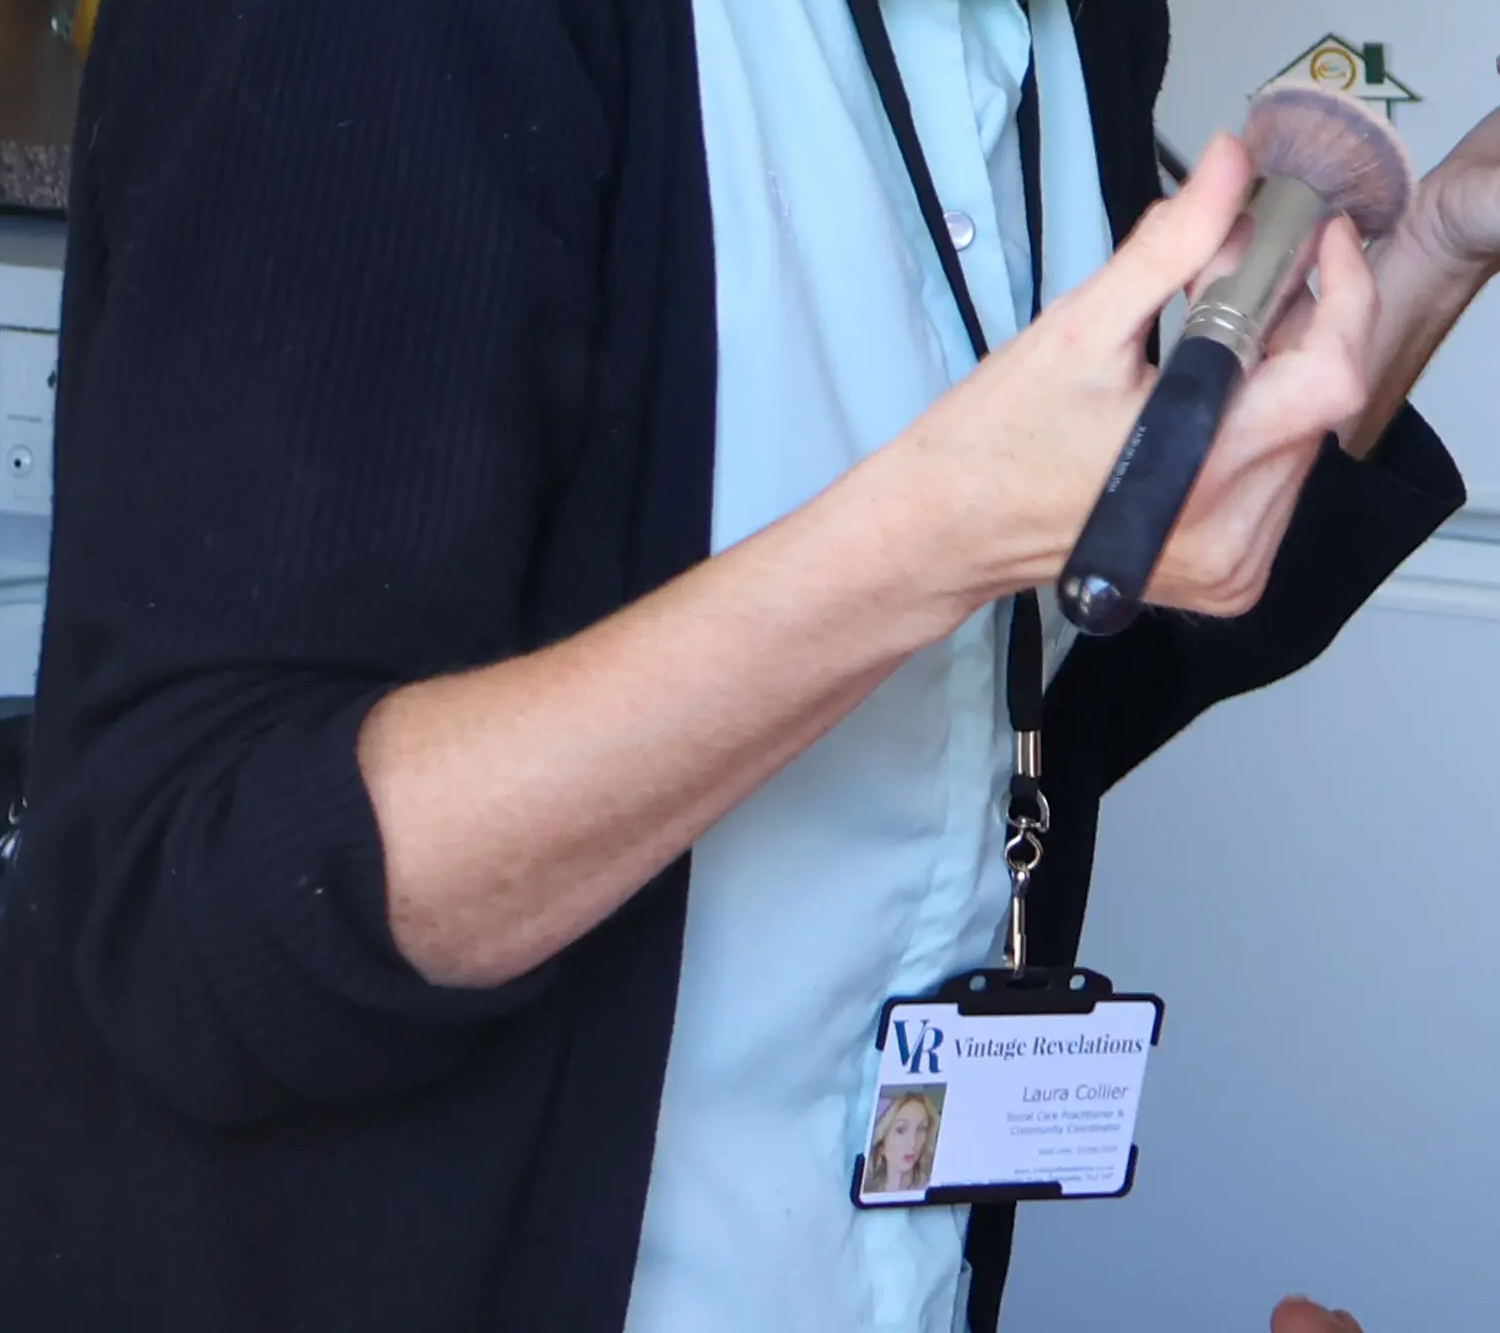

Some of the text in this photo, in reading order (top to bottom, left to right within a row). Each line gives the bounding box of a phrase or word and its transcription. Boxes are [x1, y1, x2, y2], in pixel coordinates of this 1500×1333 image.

[893, 1018, 944, 1075] VR
[954, 1033, 1144, 1061] Vintage Revelations
[1023, 1083, 1130, 1103] Laura Collier
[1010, 1124, 1064, 1136] Community
